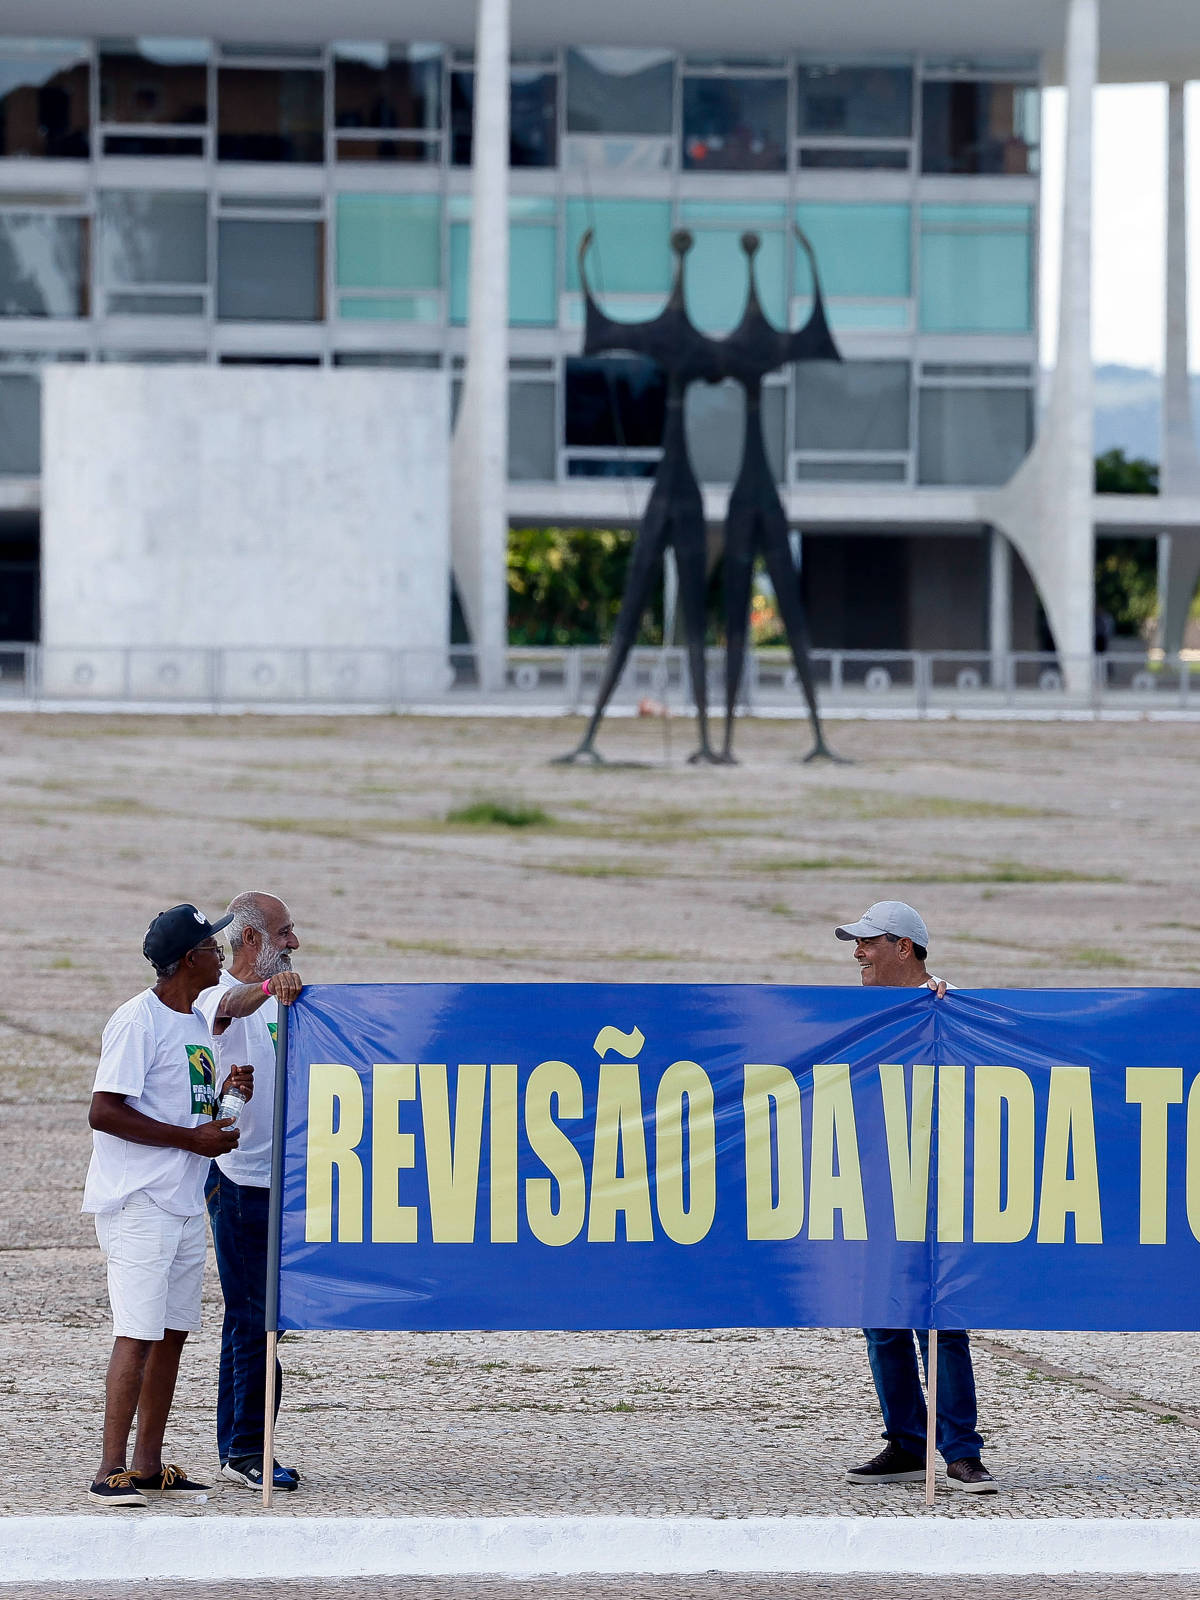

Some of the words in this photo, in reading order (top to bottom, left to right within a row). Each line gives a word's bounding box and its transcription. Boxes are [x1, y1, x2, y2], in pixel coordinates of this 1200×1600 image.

[304, 1025, 716, 1247] REVISÃO
[744, 1064, 868, 1241] DA
[878, 1065, 1103, 1243] VIDA
